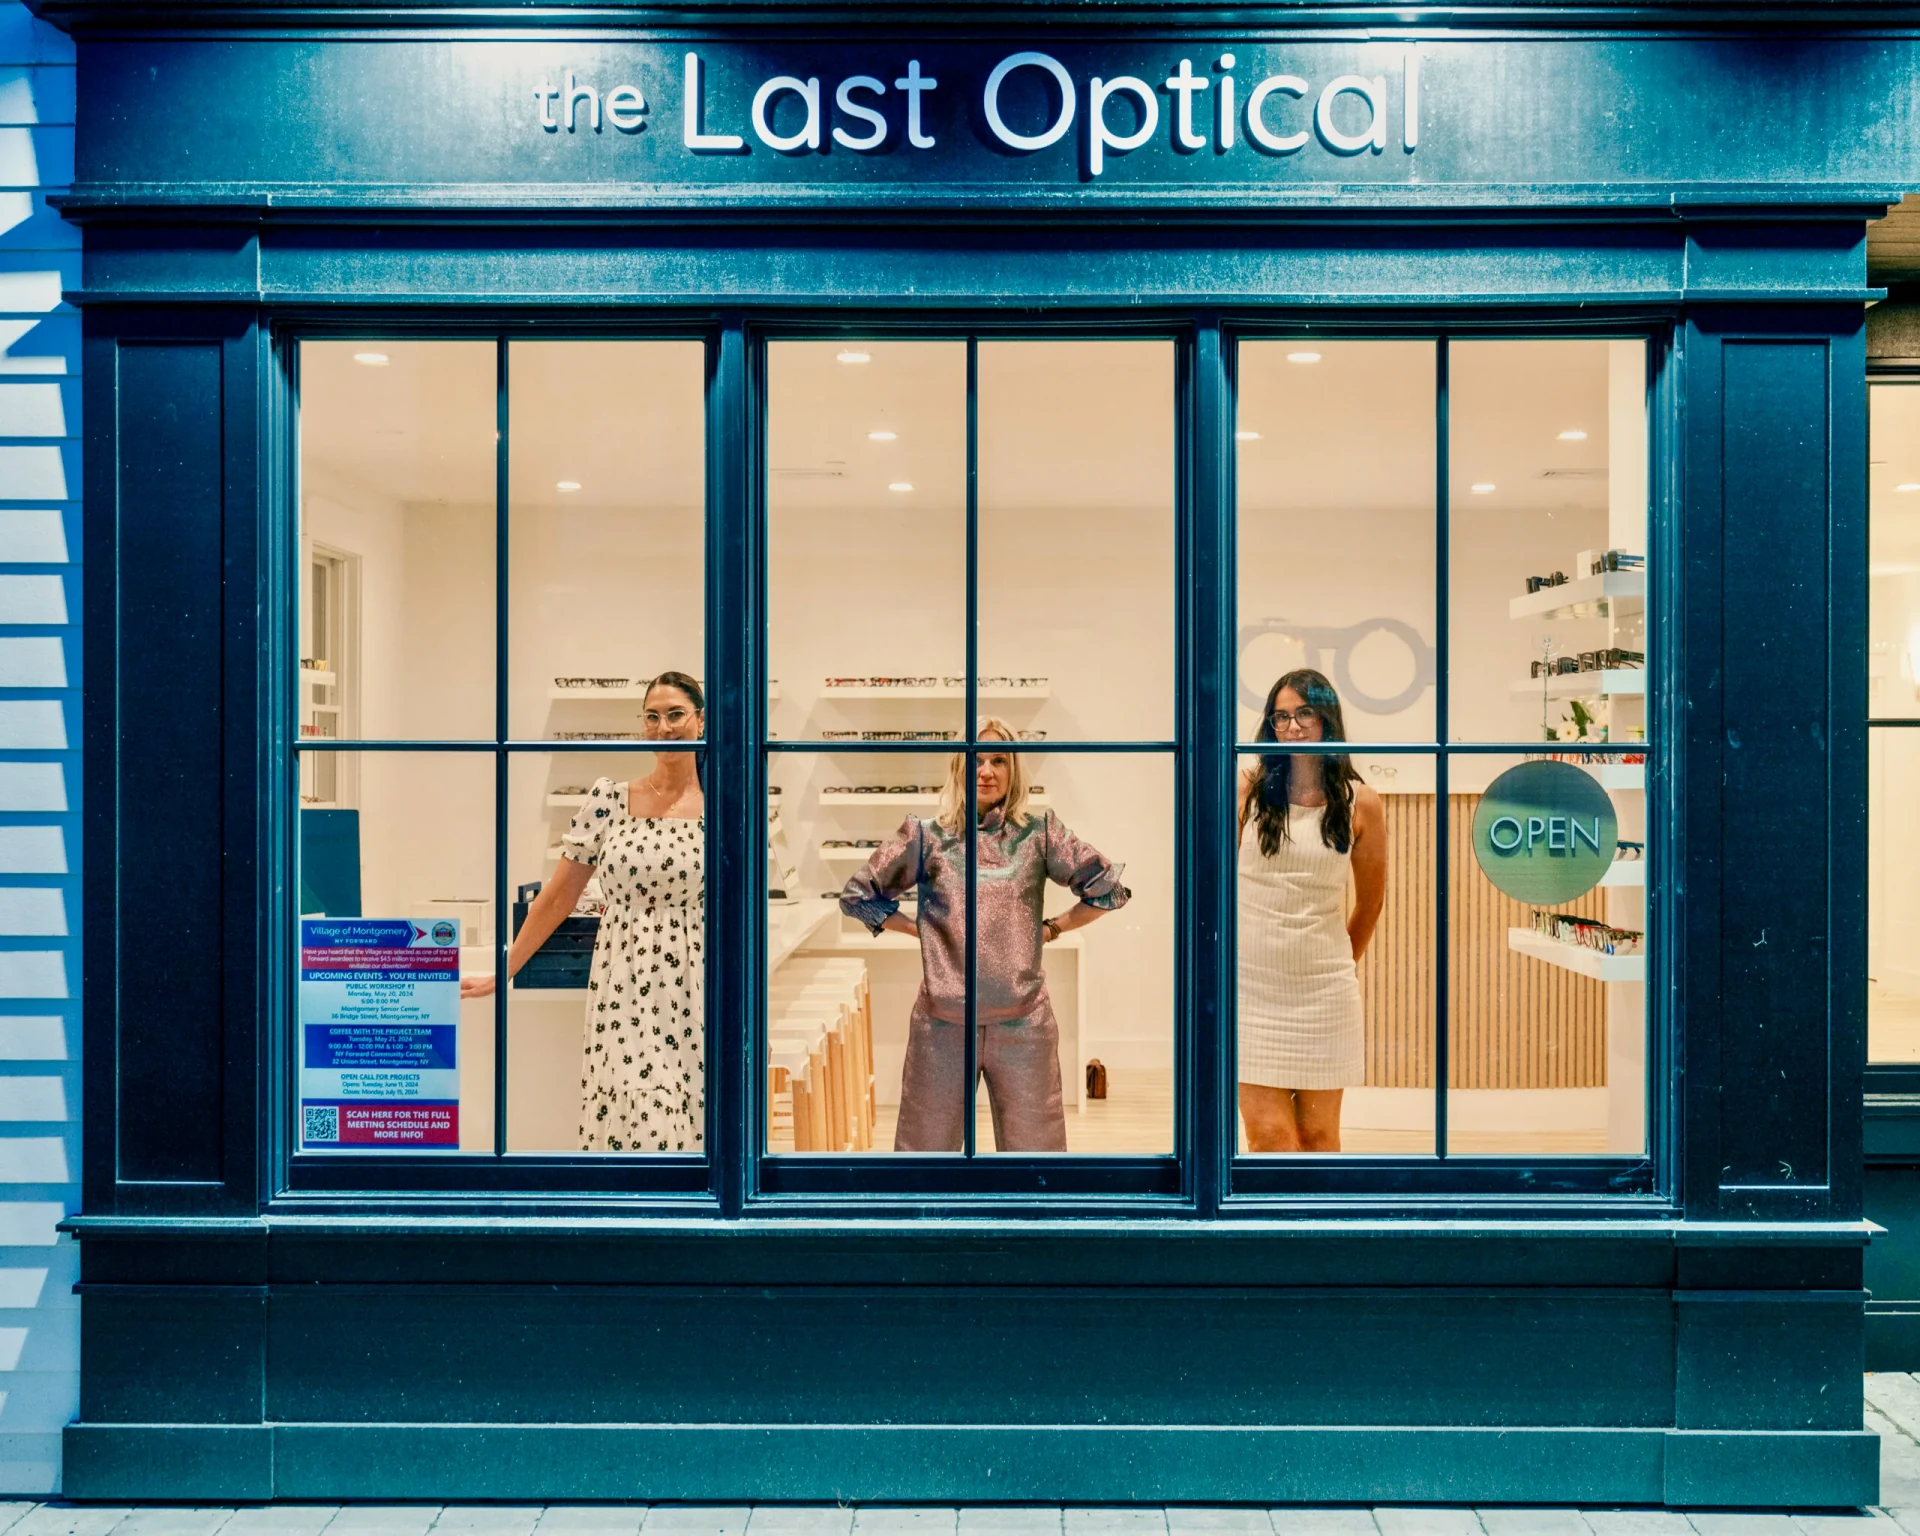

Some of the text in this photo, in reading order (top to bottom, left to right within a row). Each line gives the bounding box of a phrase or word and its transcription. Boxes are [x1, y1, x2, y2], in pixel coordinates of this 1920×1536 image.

[533, 51, 1421, 176] the Last Optical
[1490, 816, 1599, 849] OPEN
[311, 927, 407, 937] Village of Montgomery
[347, 1111, 450, 1119] SCAN HERE FOR THE FULL
